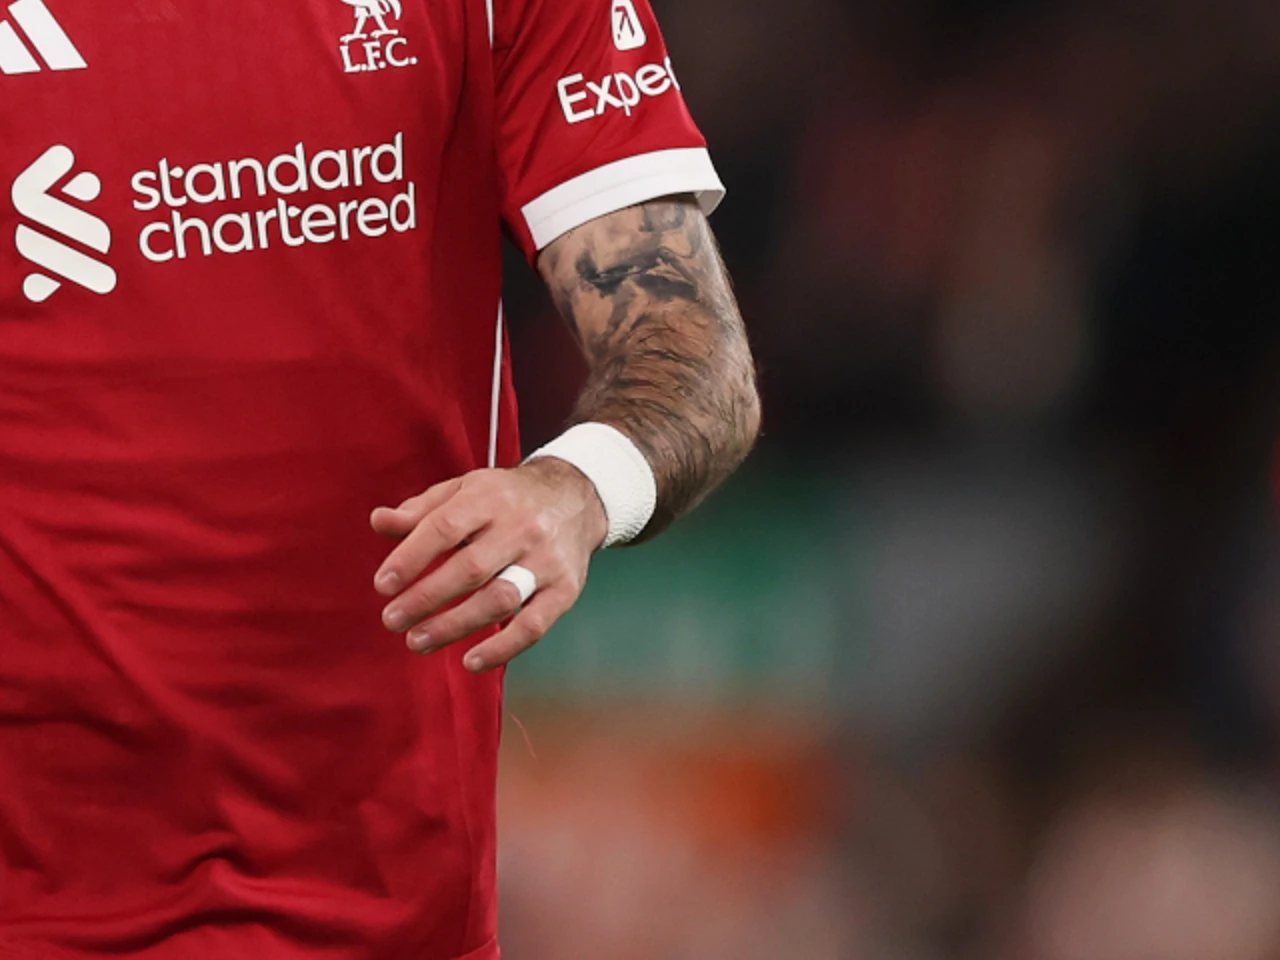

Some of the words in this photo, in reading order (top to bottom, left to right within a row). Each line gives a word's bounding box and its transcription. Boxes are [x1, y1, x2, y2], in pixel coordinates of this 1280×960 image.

[339, 37, 419, 73] L.F.C.
[130, 131, 404, 211] standard
[138, 181, 417, 263] chartered
